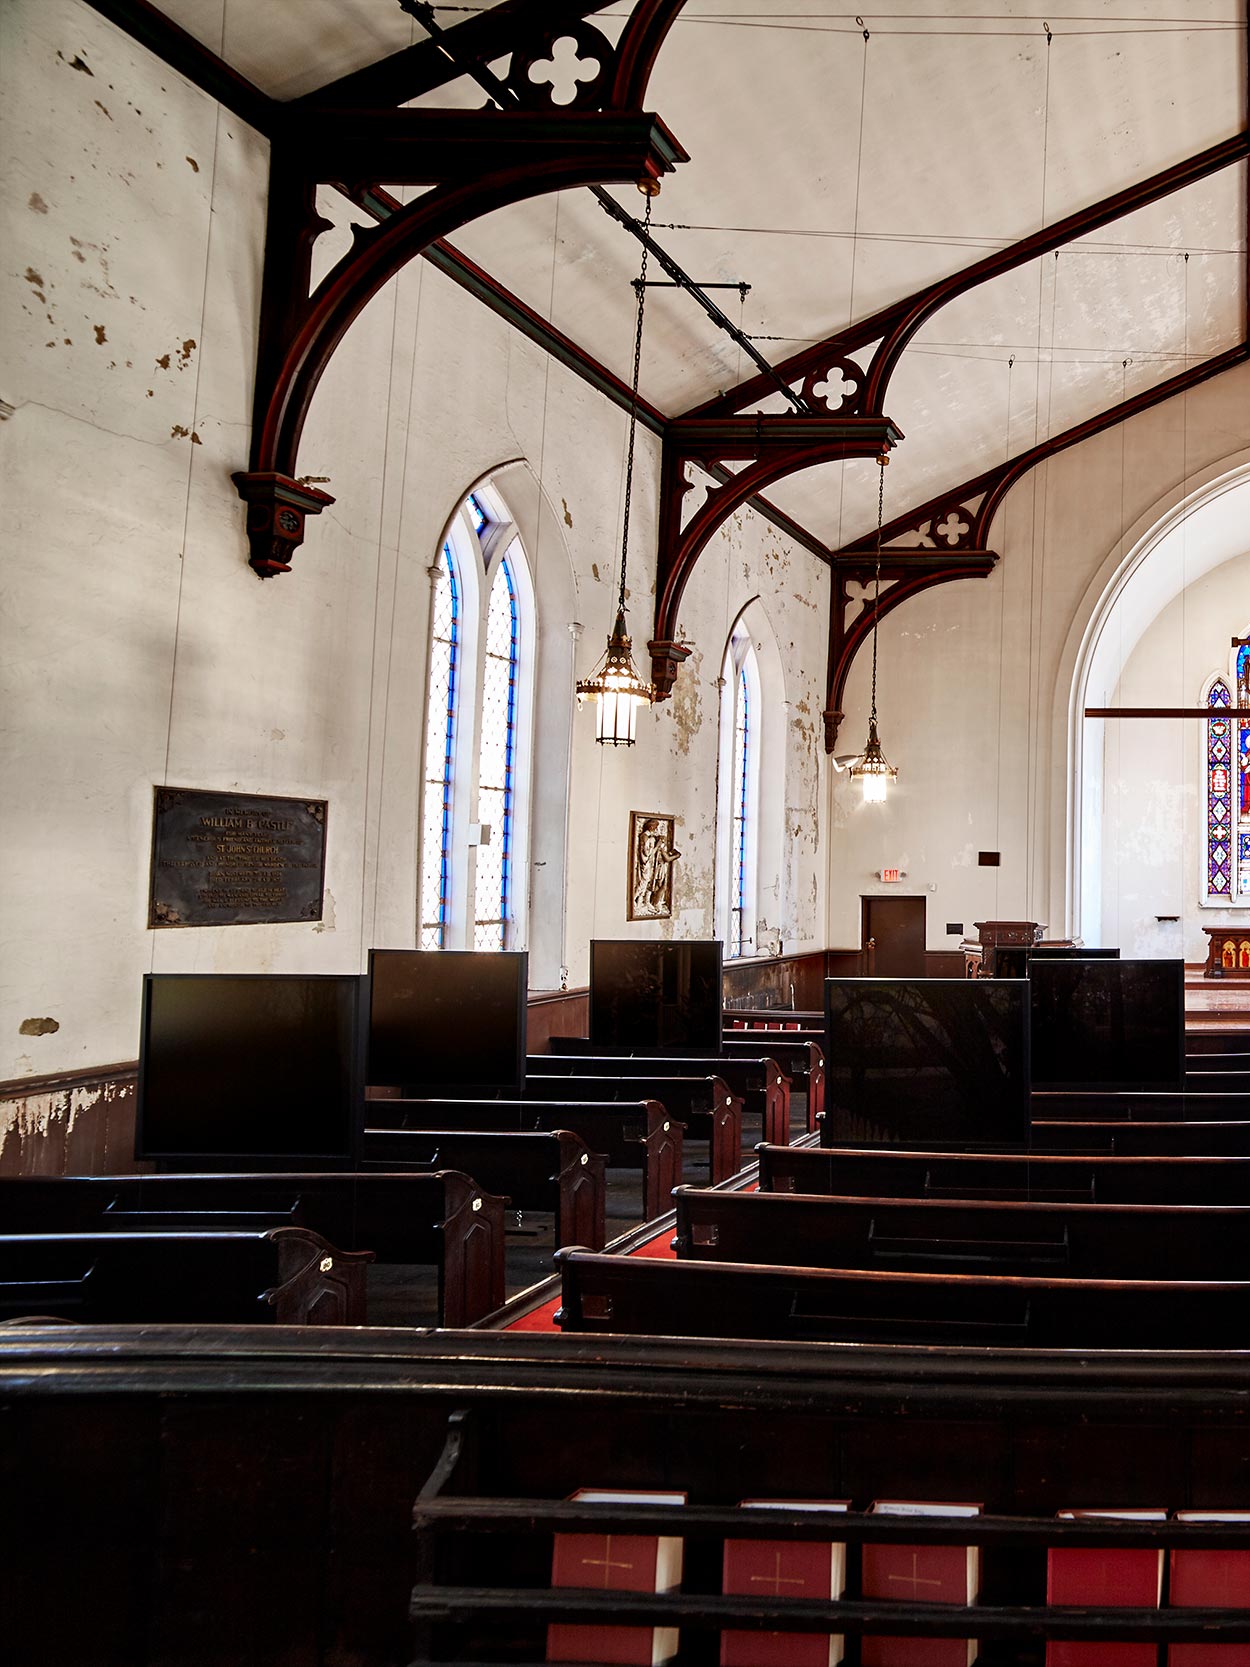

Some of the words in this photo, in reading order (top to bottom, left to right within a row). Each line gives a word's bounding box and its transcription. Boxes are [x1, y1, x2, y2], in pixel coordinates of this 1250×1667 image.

[201, 817, 242, 828] WILLIAM
[257, 819, 293, 831] CASTLE
[253, 846, 280, 854] CHURCH
[884, 869, 899, 881] EXIT
